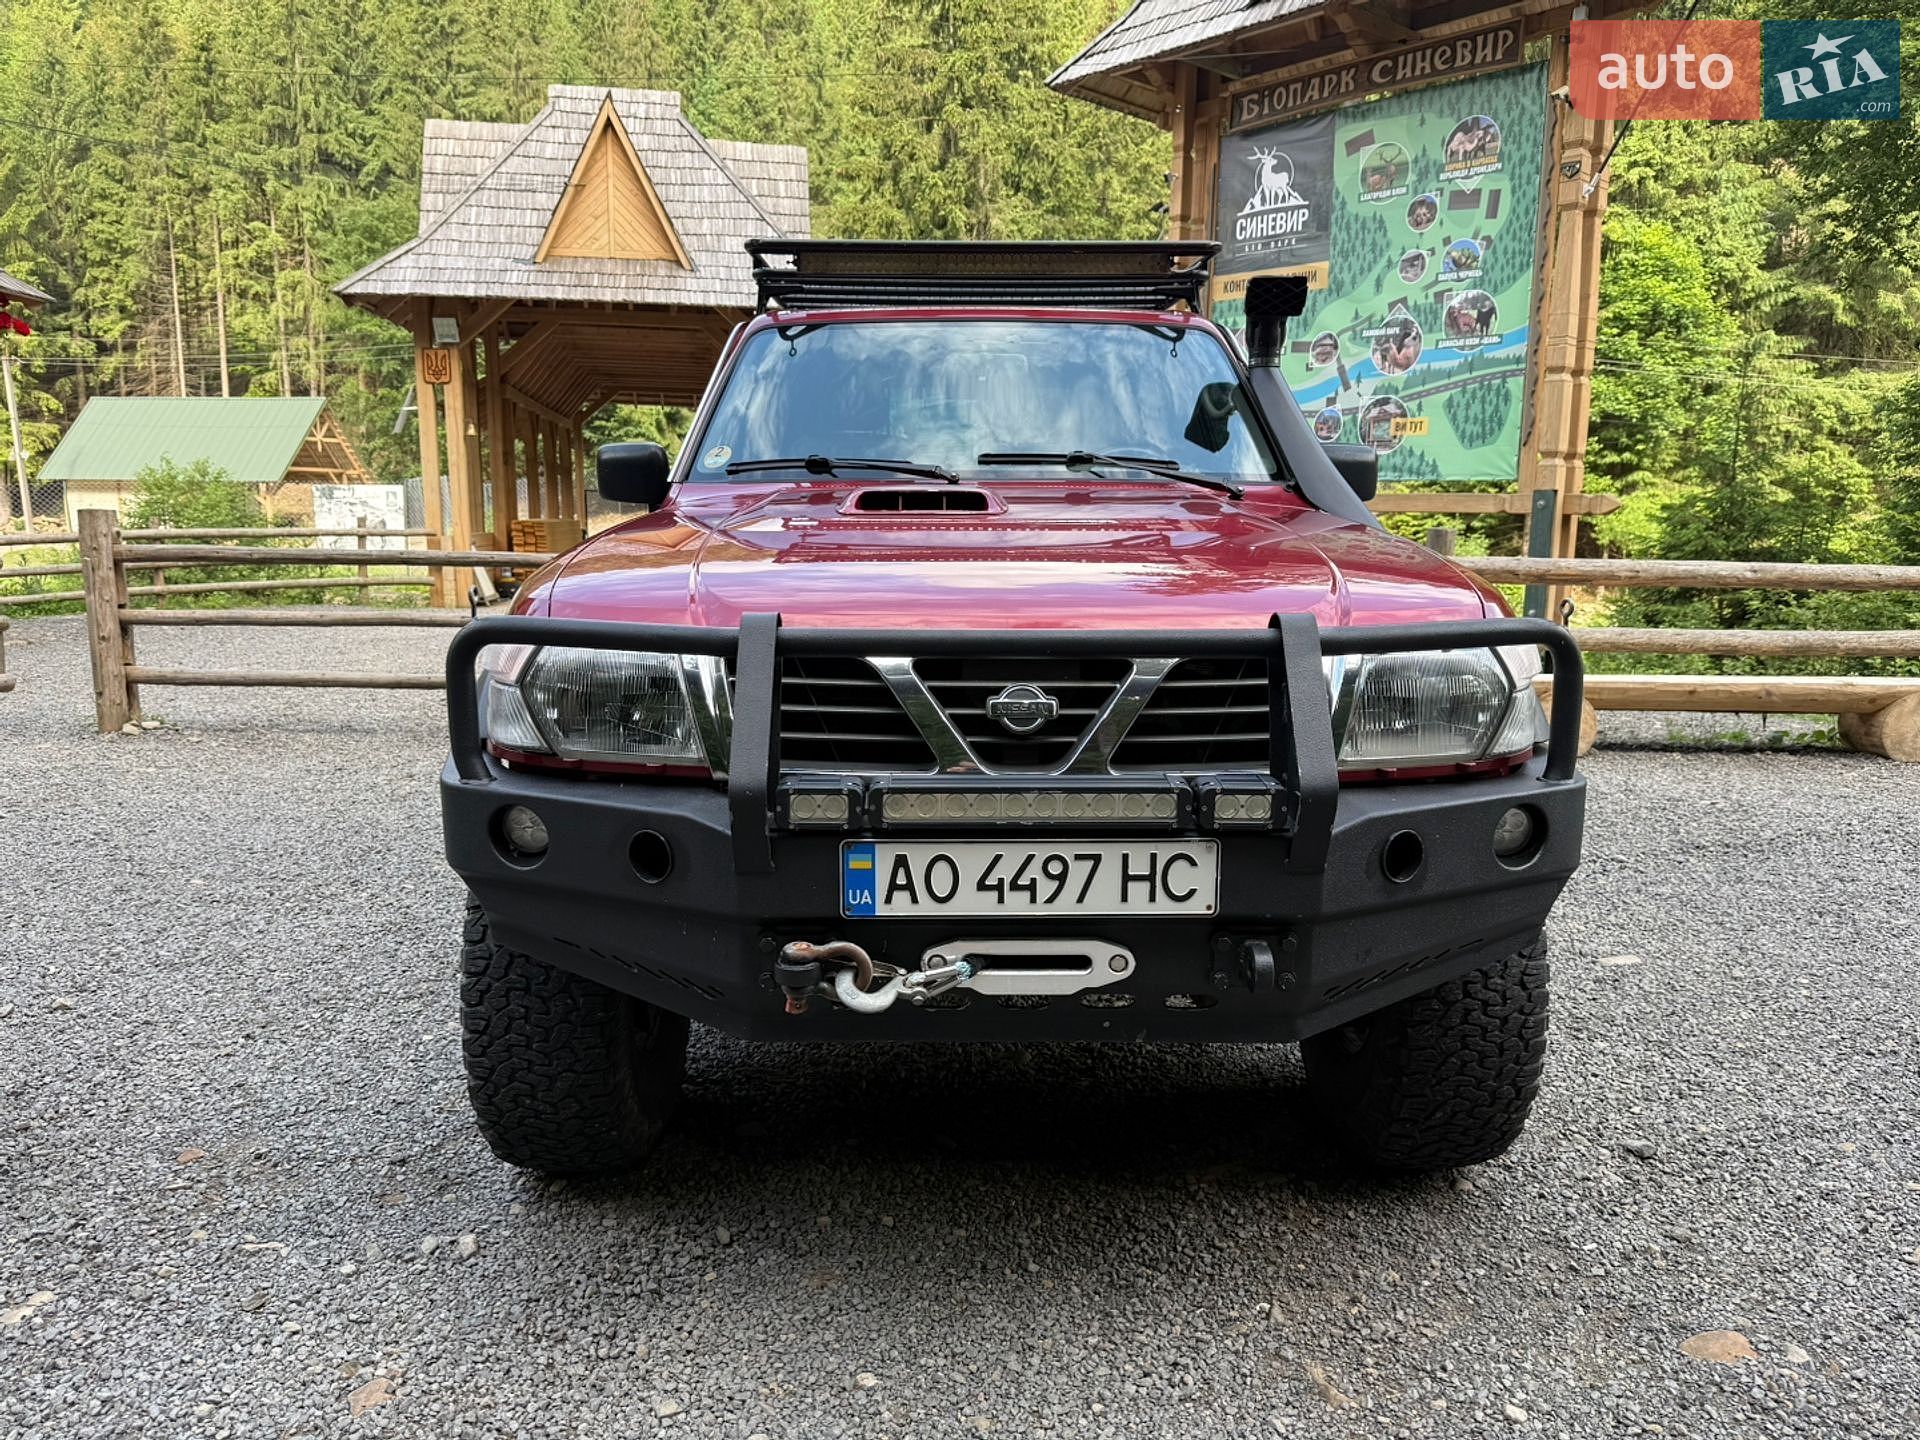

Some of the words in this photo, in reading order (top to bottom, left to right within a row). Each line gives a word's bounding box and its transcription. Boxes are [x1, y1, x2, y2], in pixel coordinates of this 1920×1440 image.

[1235, 208, 1310, 240] СИНЕВИР
[1395, 418, 1407, 431] ВИ
[1409, 418, 1424, 432] ТУТ
[996, 703, 1048, 714] NISSAN
[976, 852, 1103, 904] 4497
[849, 889, 872, 905] UA
